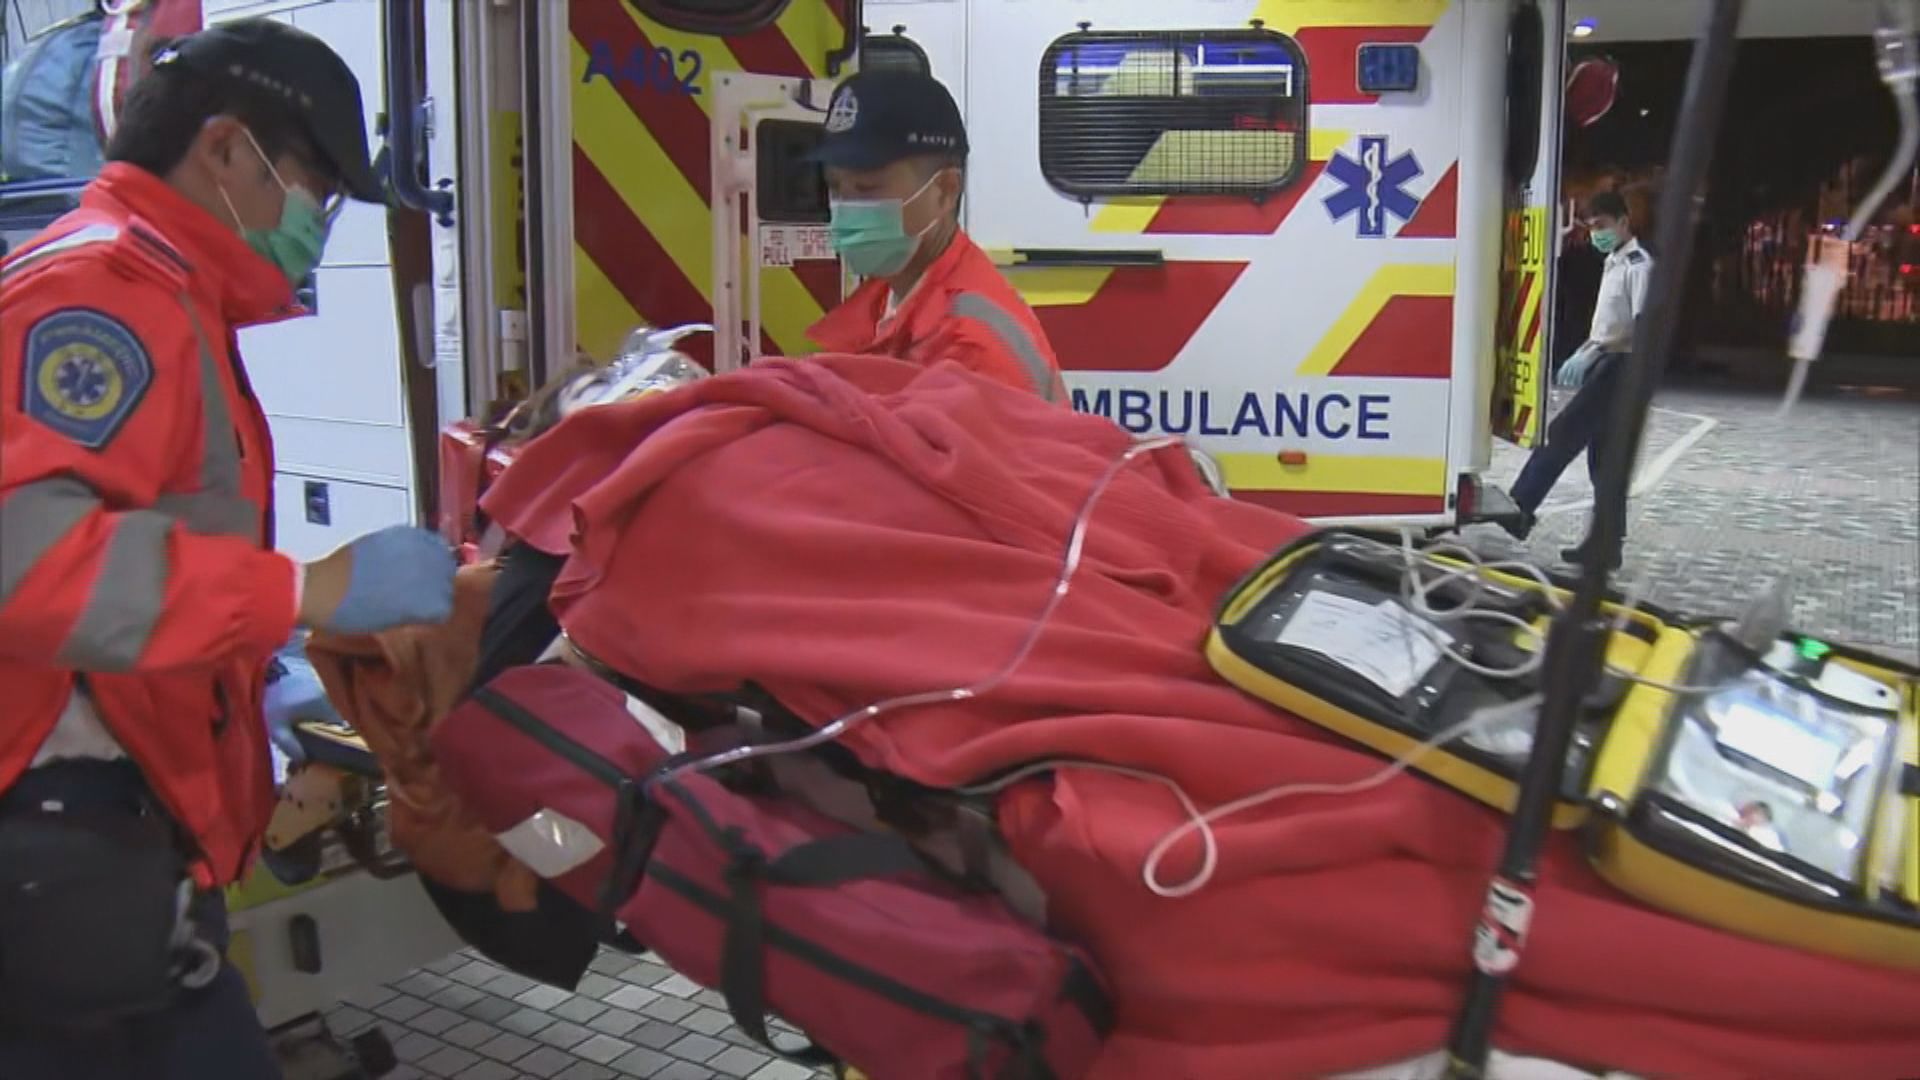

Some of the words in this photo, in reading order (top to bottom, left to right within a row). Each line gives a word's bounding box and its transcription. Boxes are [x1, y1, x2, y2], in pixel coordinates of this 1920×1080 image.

[582, 44, 703, 95] A402
[763, 245, 791, 266] PULL
[1071, 387, 1391, 441] MBULANCE
